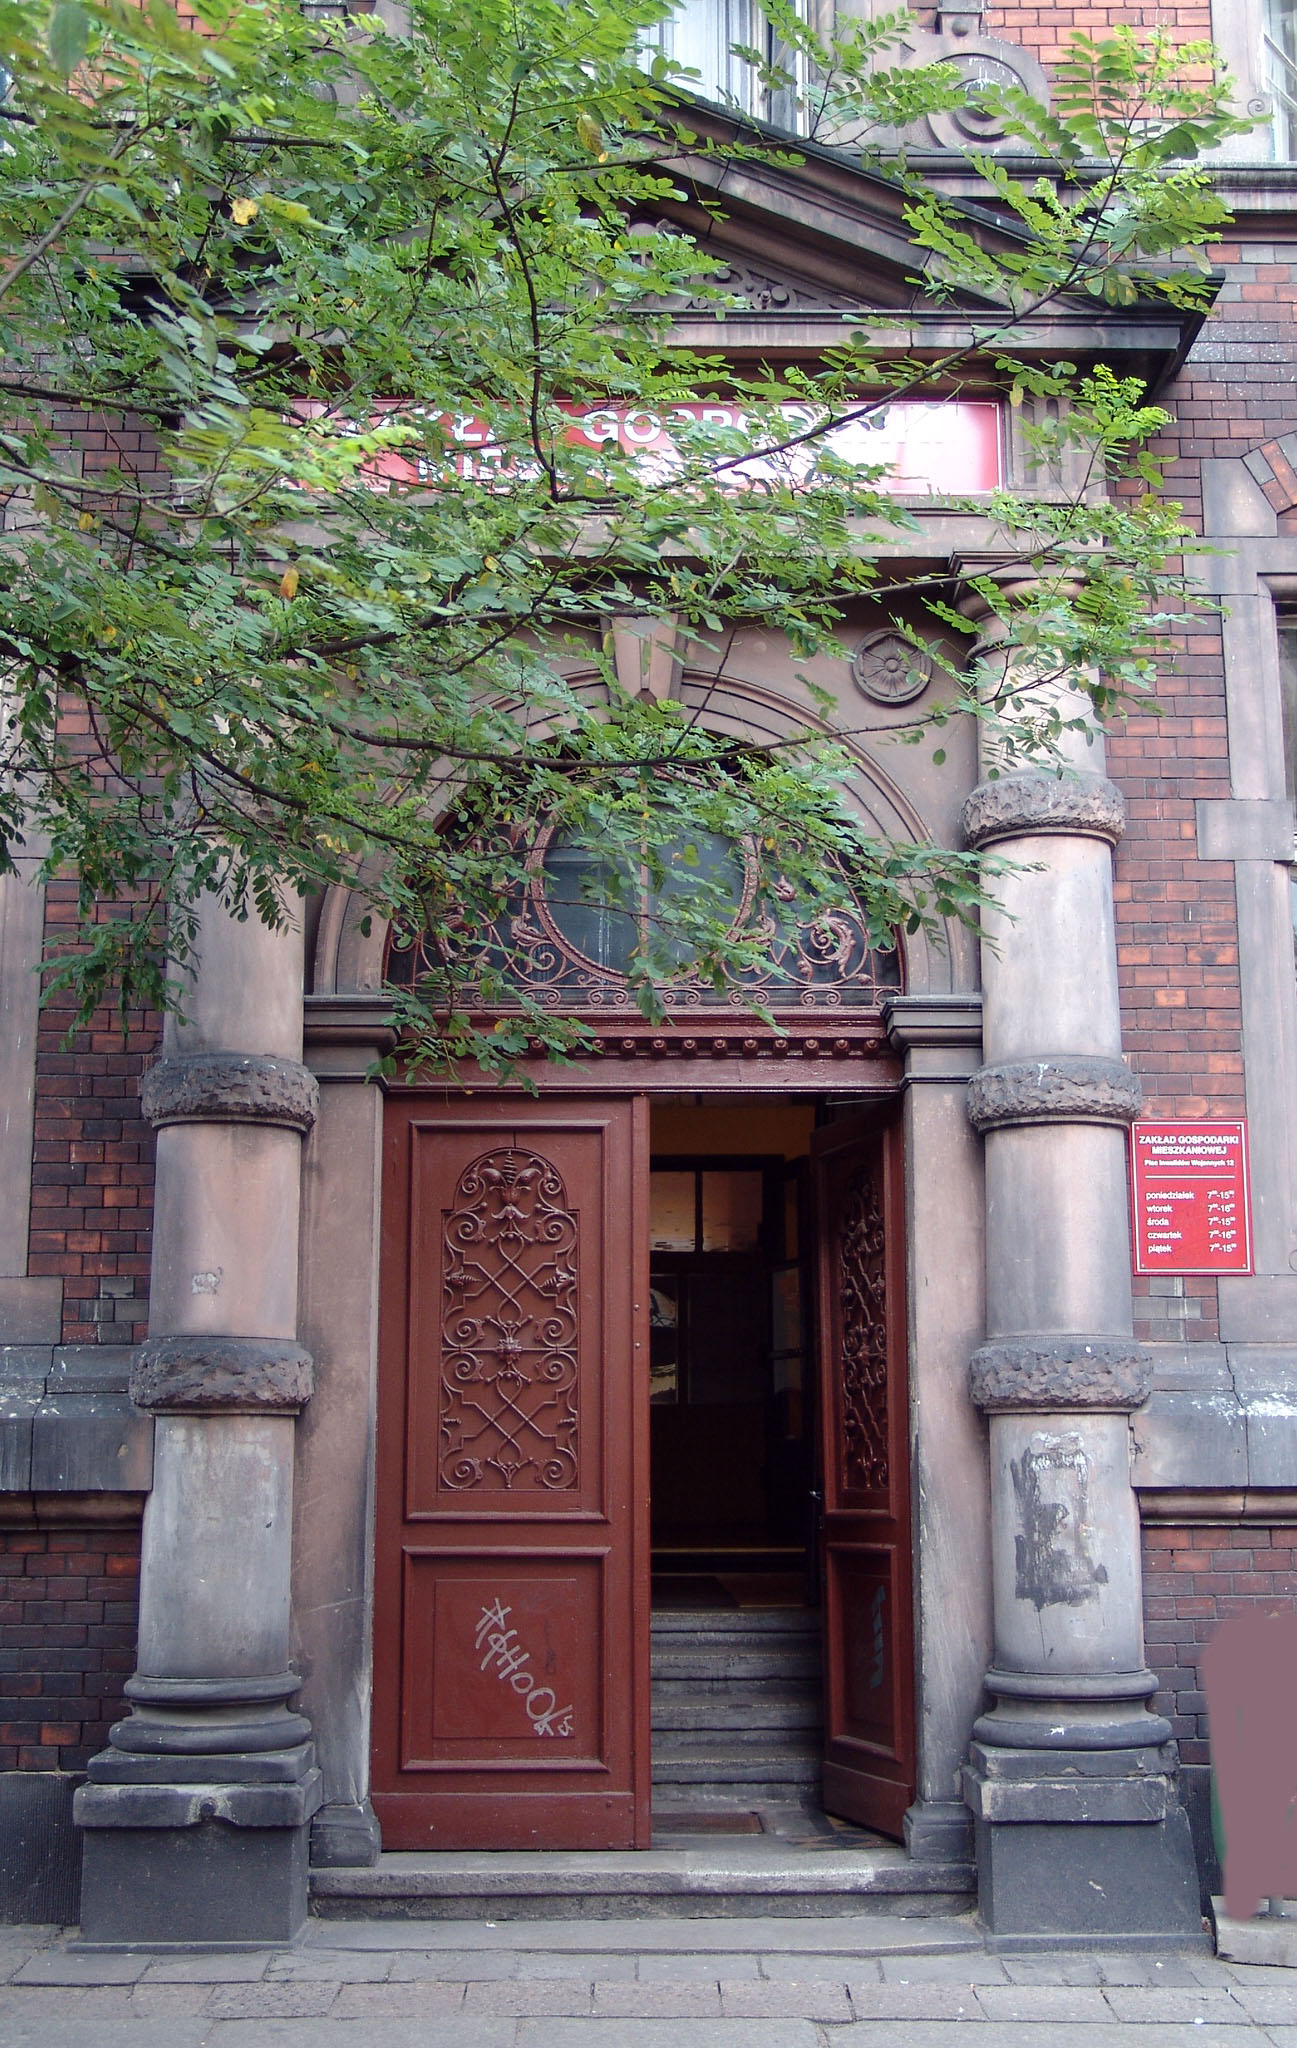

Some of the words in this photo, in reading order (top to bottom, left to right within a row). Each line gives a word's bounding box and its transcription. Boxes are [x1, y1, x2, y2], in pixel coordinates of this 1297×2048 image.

[1139, 1135, 1177, 1145] ZAKŁAD
[1178, 1135, 1239, 1145] GOSPODARKI
[1151, 1146, 1227, 1155] MIESZKANIOWEJ
[1146, 1191, 1195, 1201] poniedziałek
[1146, 1204, 1173, 1213] wtorek
[1147, 1217, 1169, 1226] środa
[1147, 1231, 1182, 1239] czwartek
[1148, 1244, 1172, 1254] piątek
